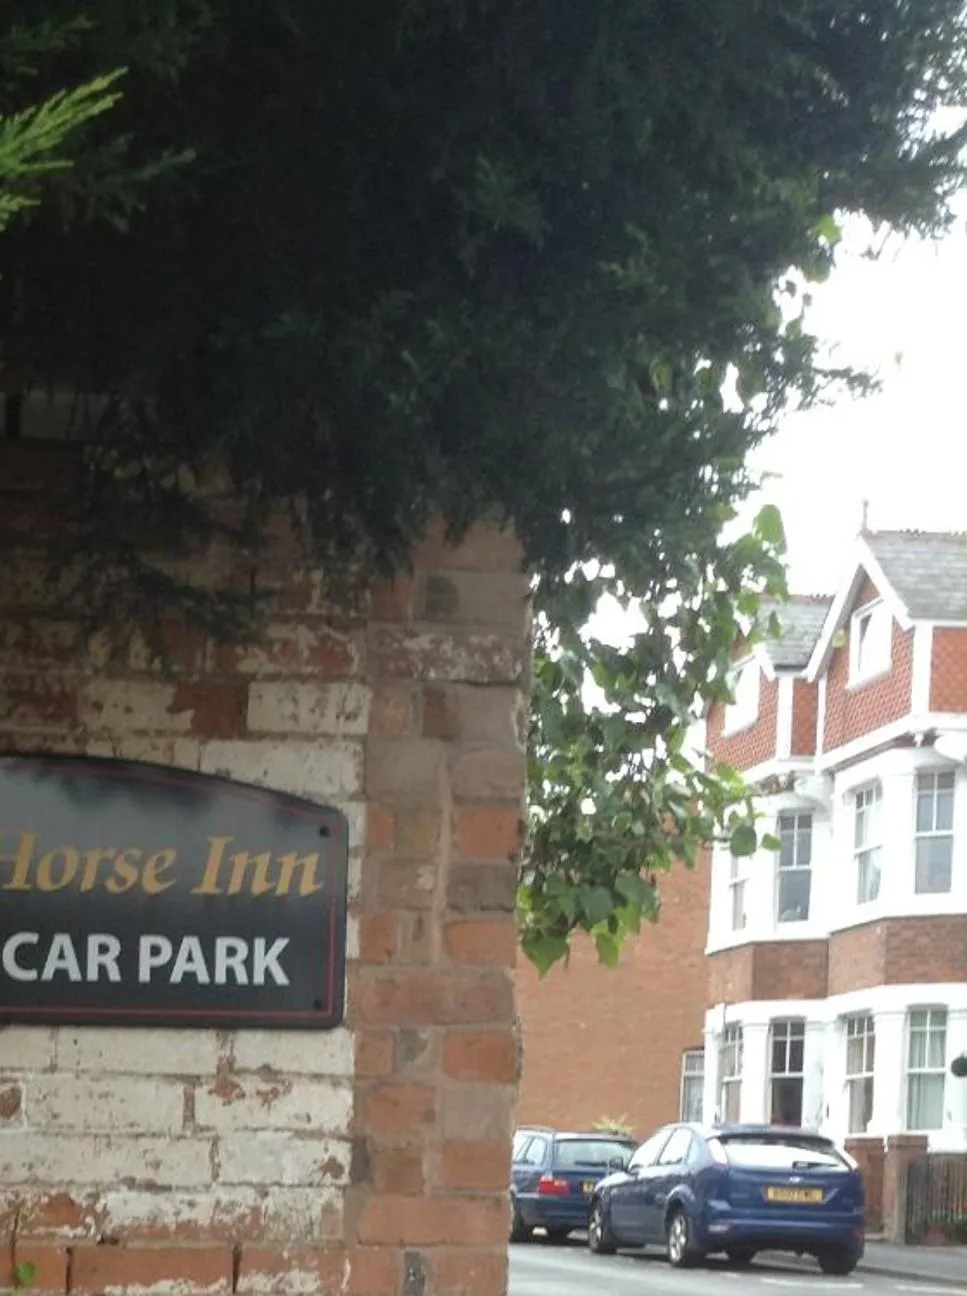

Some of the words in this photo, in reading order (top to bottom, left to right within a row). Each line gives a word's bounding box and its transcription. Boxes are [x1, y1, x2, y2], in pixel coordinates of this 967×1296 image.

[190, 834, 324, 898] Inn
[2, 931, 122, 982] CAR
[137, 936, 291, 986] PARK
